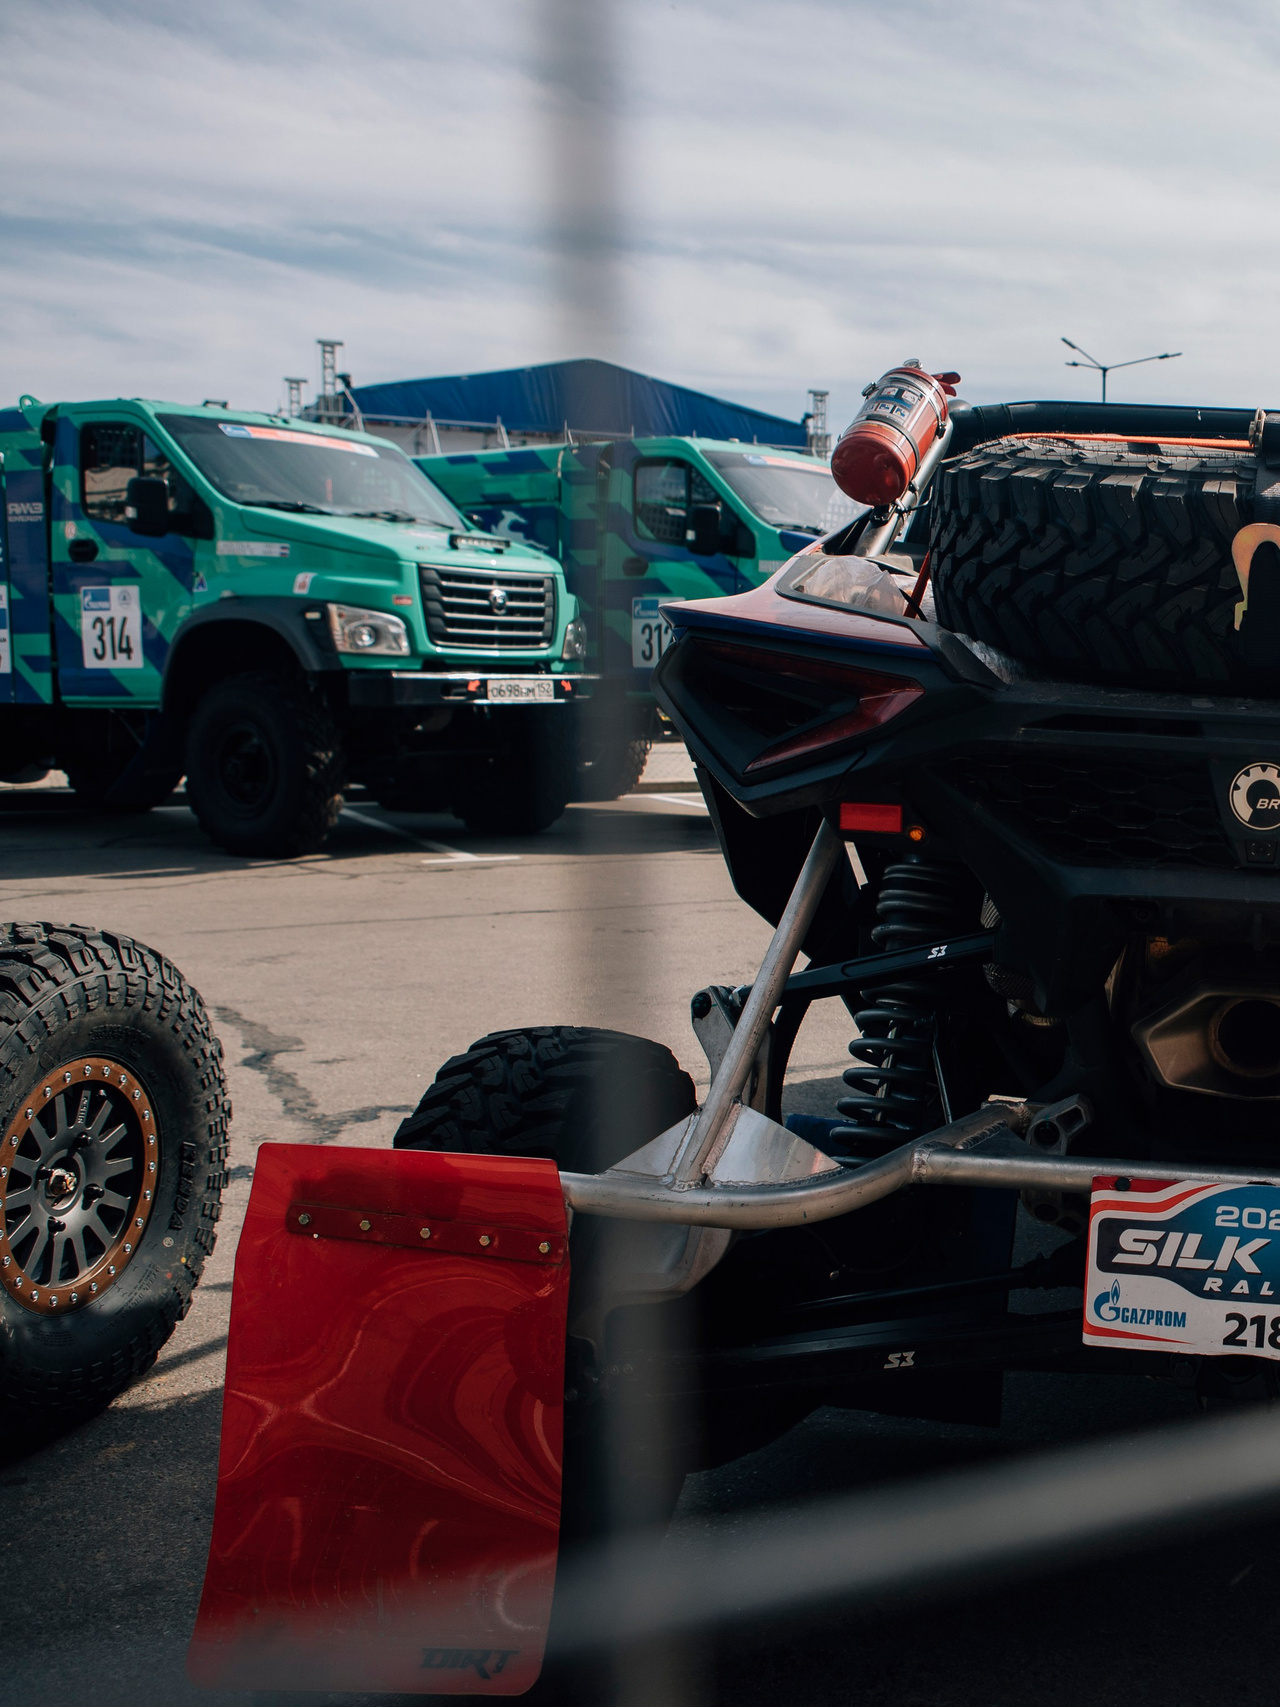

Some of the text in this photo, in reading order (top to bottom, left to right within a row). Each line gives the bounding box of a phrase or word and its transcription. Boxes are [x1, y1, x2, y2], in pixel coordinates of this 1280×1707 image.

[92, 616, 133, 661] 314
[927, 944, 948, 960] S3
[167, 1140, 198, 1231] KENDA
[1111, 1228, 1272, 1275] SILK
[1121, 1307, 1187, 1328] GAZPROM
[883, 1350, 916, 1369] S3
[420, 1648, 522, 1680] DIRT
